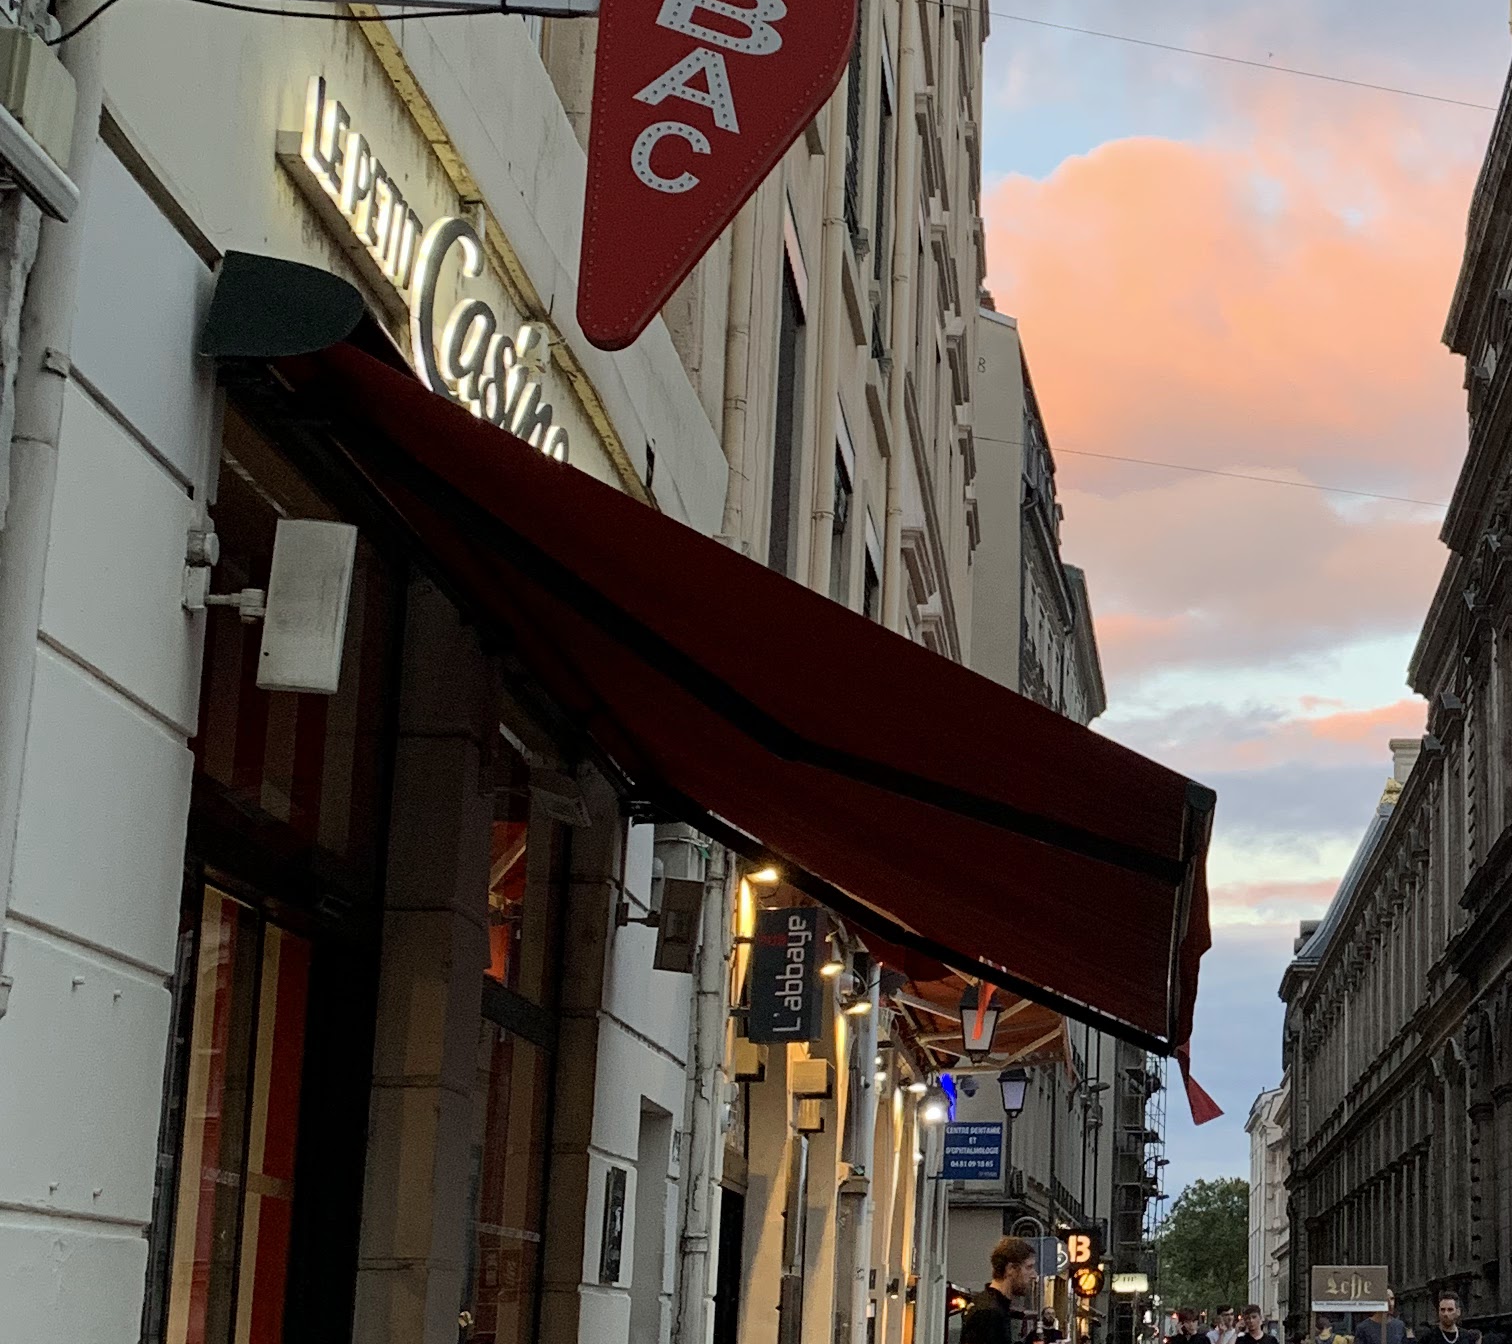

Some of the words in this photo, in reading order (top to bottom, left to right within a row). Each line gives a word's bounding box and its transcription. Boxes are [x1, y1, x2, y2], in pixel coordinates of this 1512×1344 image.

[300, 75, 350, 195] LE
[341, 131, 424, 290] PETIT
[772, 915, 813, 1033] L'abbaye
